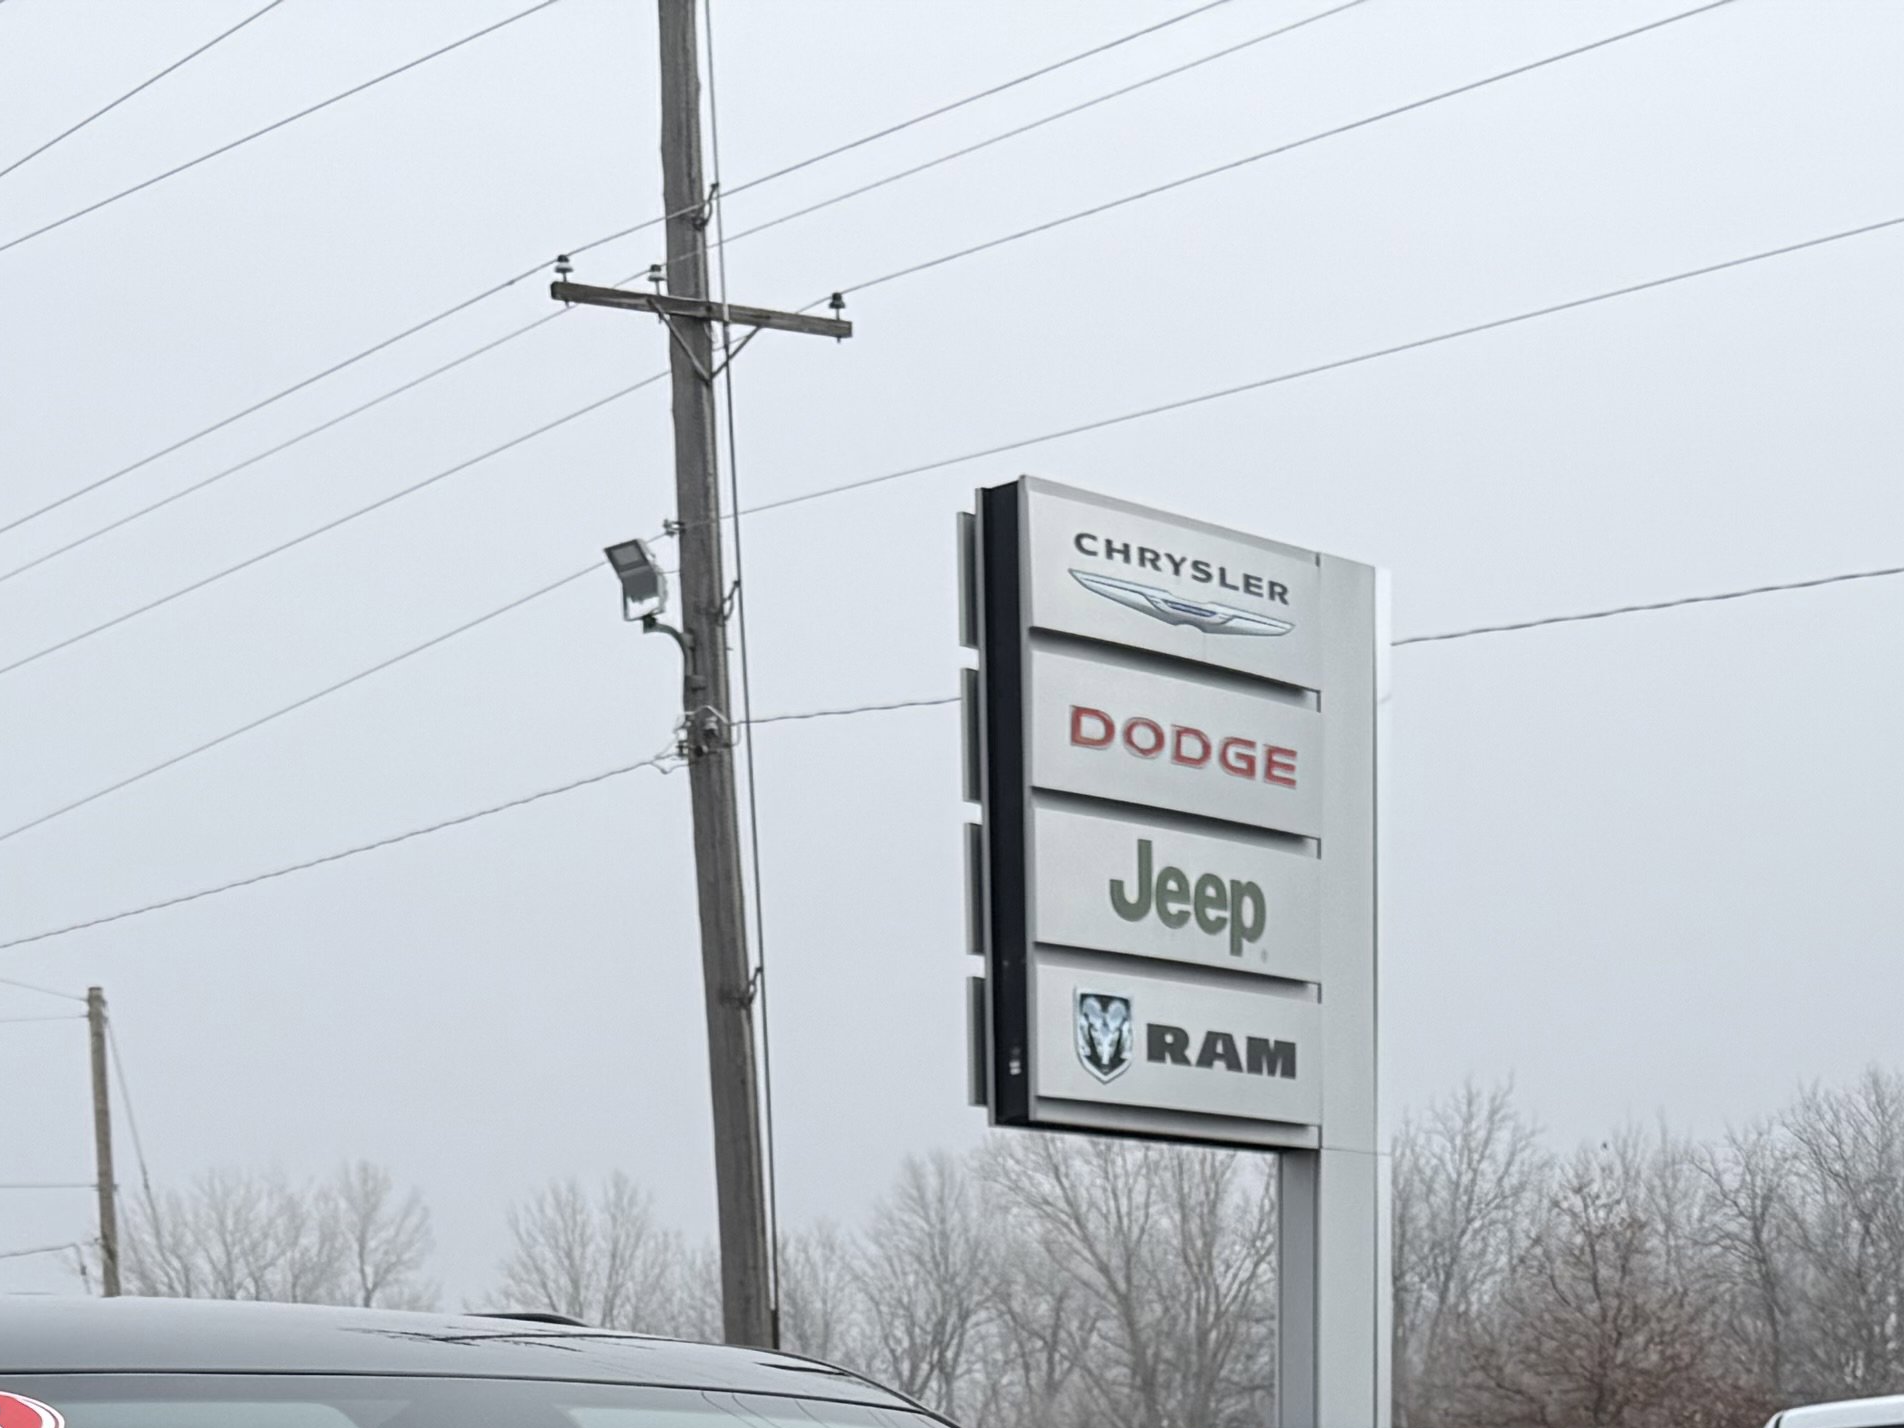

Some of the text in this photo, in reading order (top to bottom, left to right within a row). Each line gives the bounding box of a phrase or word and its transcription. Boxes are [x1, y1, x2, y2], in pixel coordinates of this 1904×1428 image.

[1074, 532, 1290, 606] CHRYSLER
[1070, 704, 1298, 789] DODGE
[1109, 838, 1267, 957] Jeep
[1146, 1022, 1297, 1080] RAM
